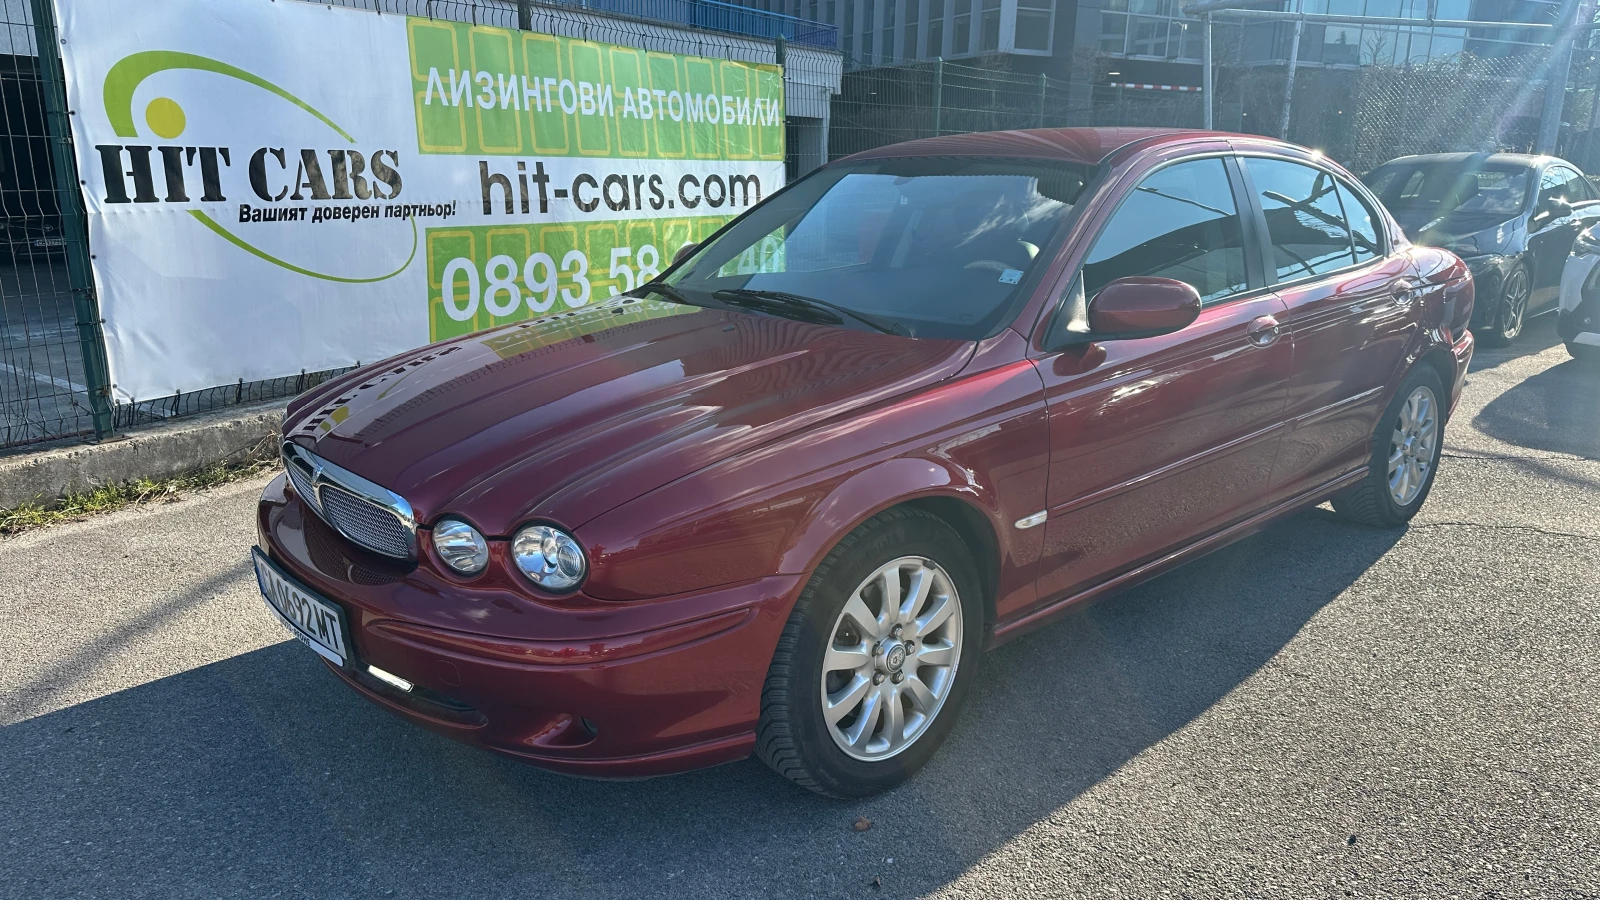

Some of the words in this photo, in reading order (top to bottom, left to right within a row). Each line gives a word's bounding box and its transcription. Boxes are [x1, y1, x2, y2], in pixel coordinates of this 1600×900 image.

[425, 67, 615, 118] ЛИЗИНГОВИ
[623, 87, 780, 127] АВТОМОБИЛИ
[95, 145, 231, 204] HIT
[248, 147, 402, 202] CARS
[479, 160, 761, 216] hit-cars.com
[239, 203, 308, 223] Вашият
[311, 205, 380, 223] доверен
[384, 200, 457, 220] партньор!
[441, 247, 591, 322] 0893
